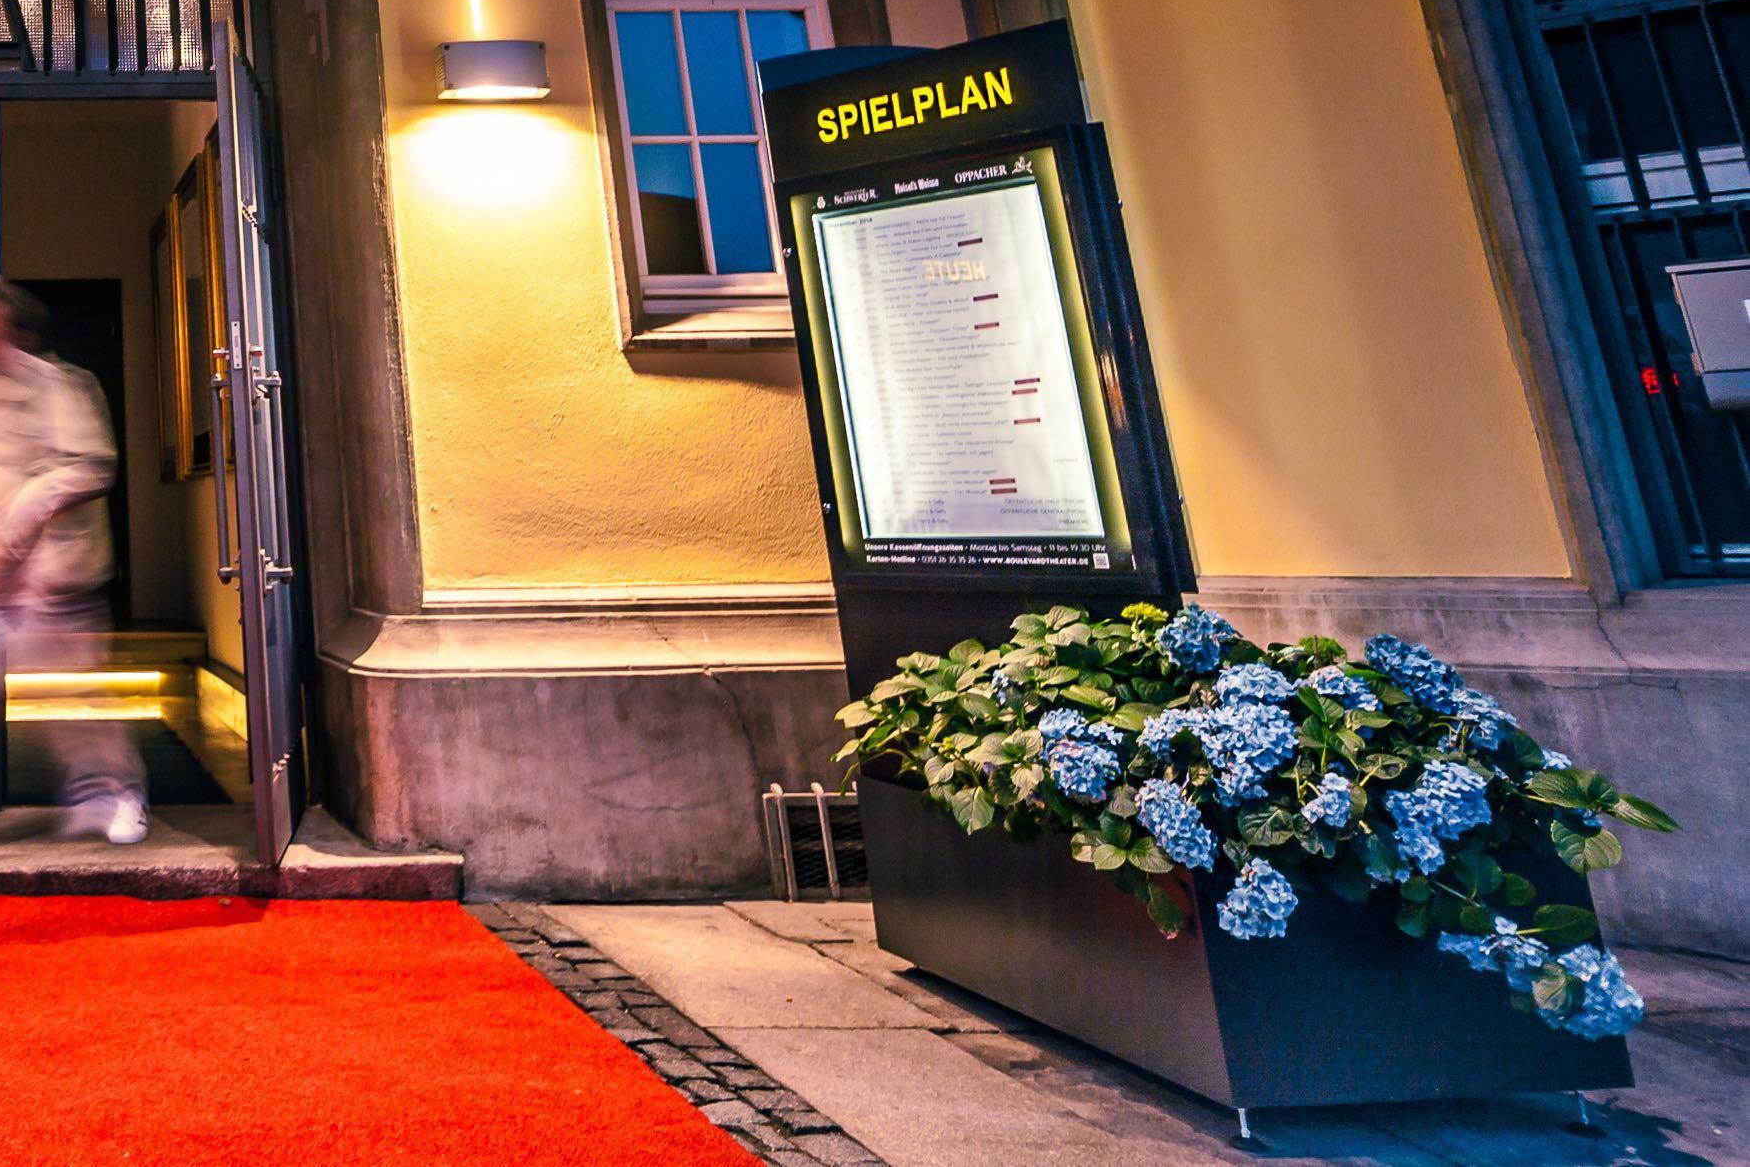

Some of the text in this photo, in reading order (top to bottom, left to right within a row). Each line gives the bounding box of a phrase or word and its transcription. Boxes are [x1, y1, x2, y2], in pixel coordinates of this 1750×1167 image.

[816, 67, 1013, 143] SPIELPLAN
[954, 164, 1007, 184] OPPACHER
[1010, 543, 1042, 553] Samstag
